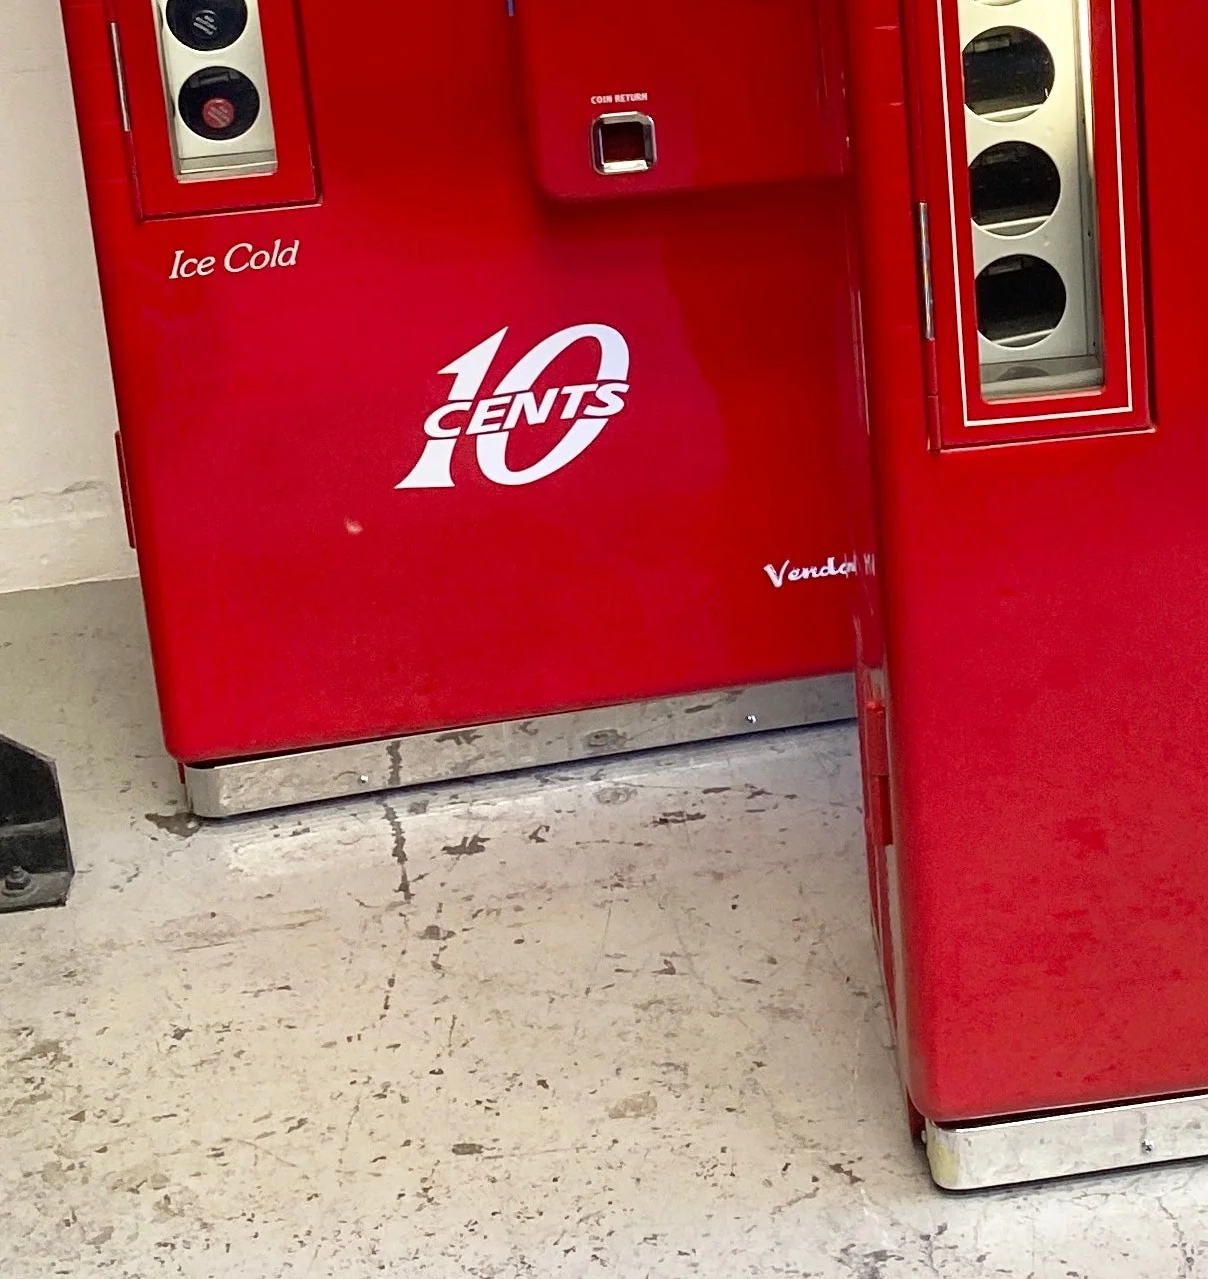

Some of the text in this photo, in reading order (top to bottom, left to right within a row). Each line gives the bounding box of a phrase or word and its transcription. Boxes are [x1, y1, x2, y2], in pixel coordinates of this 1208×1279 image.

[590, 92, 648, 105] COIN RETURN
[169, 239, 300, 279] Ice Cold
[395, 323, 630, 489] 10
[422, 381, 631, 440] CENTS
